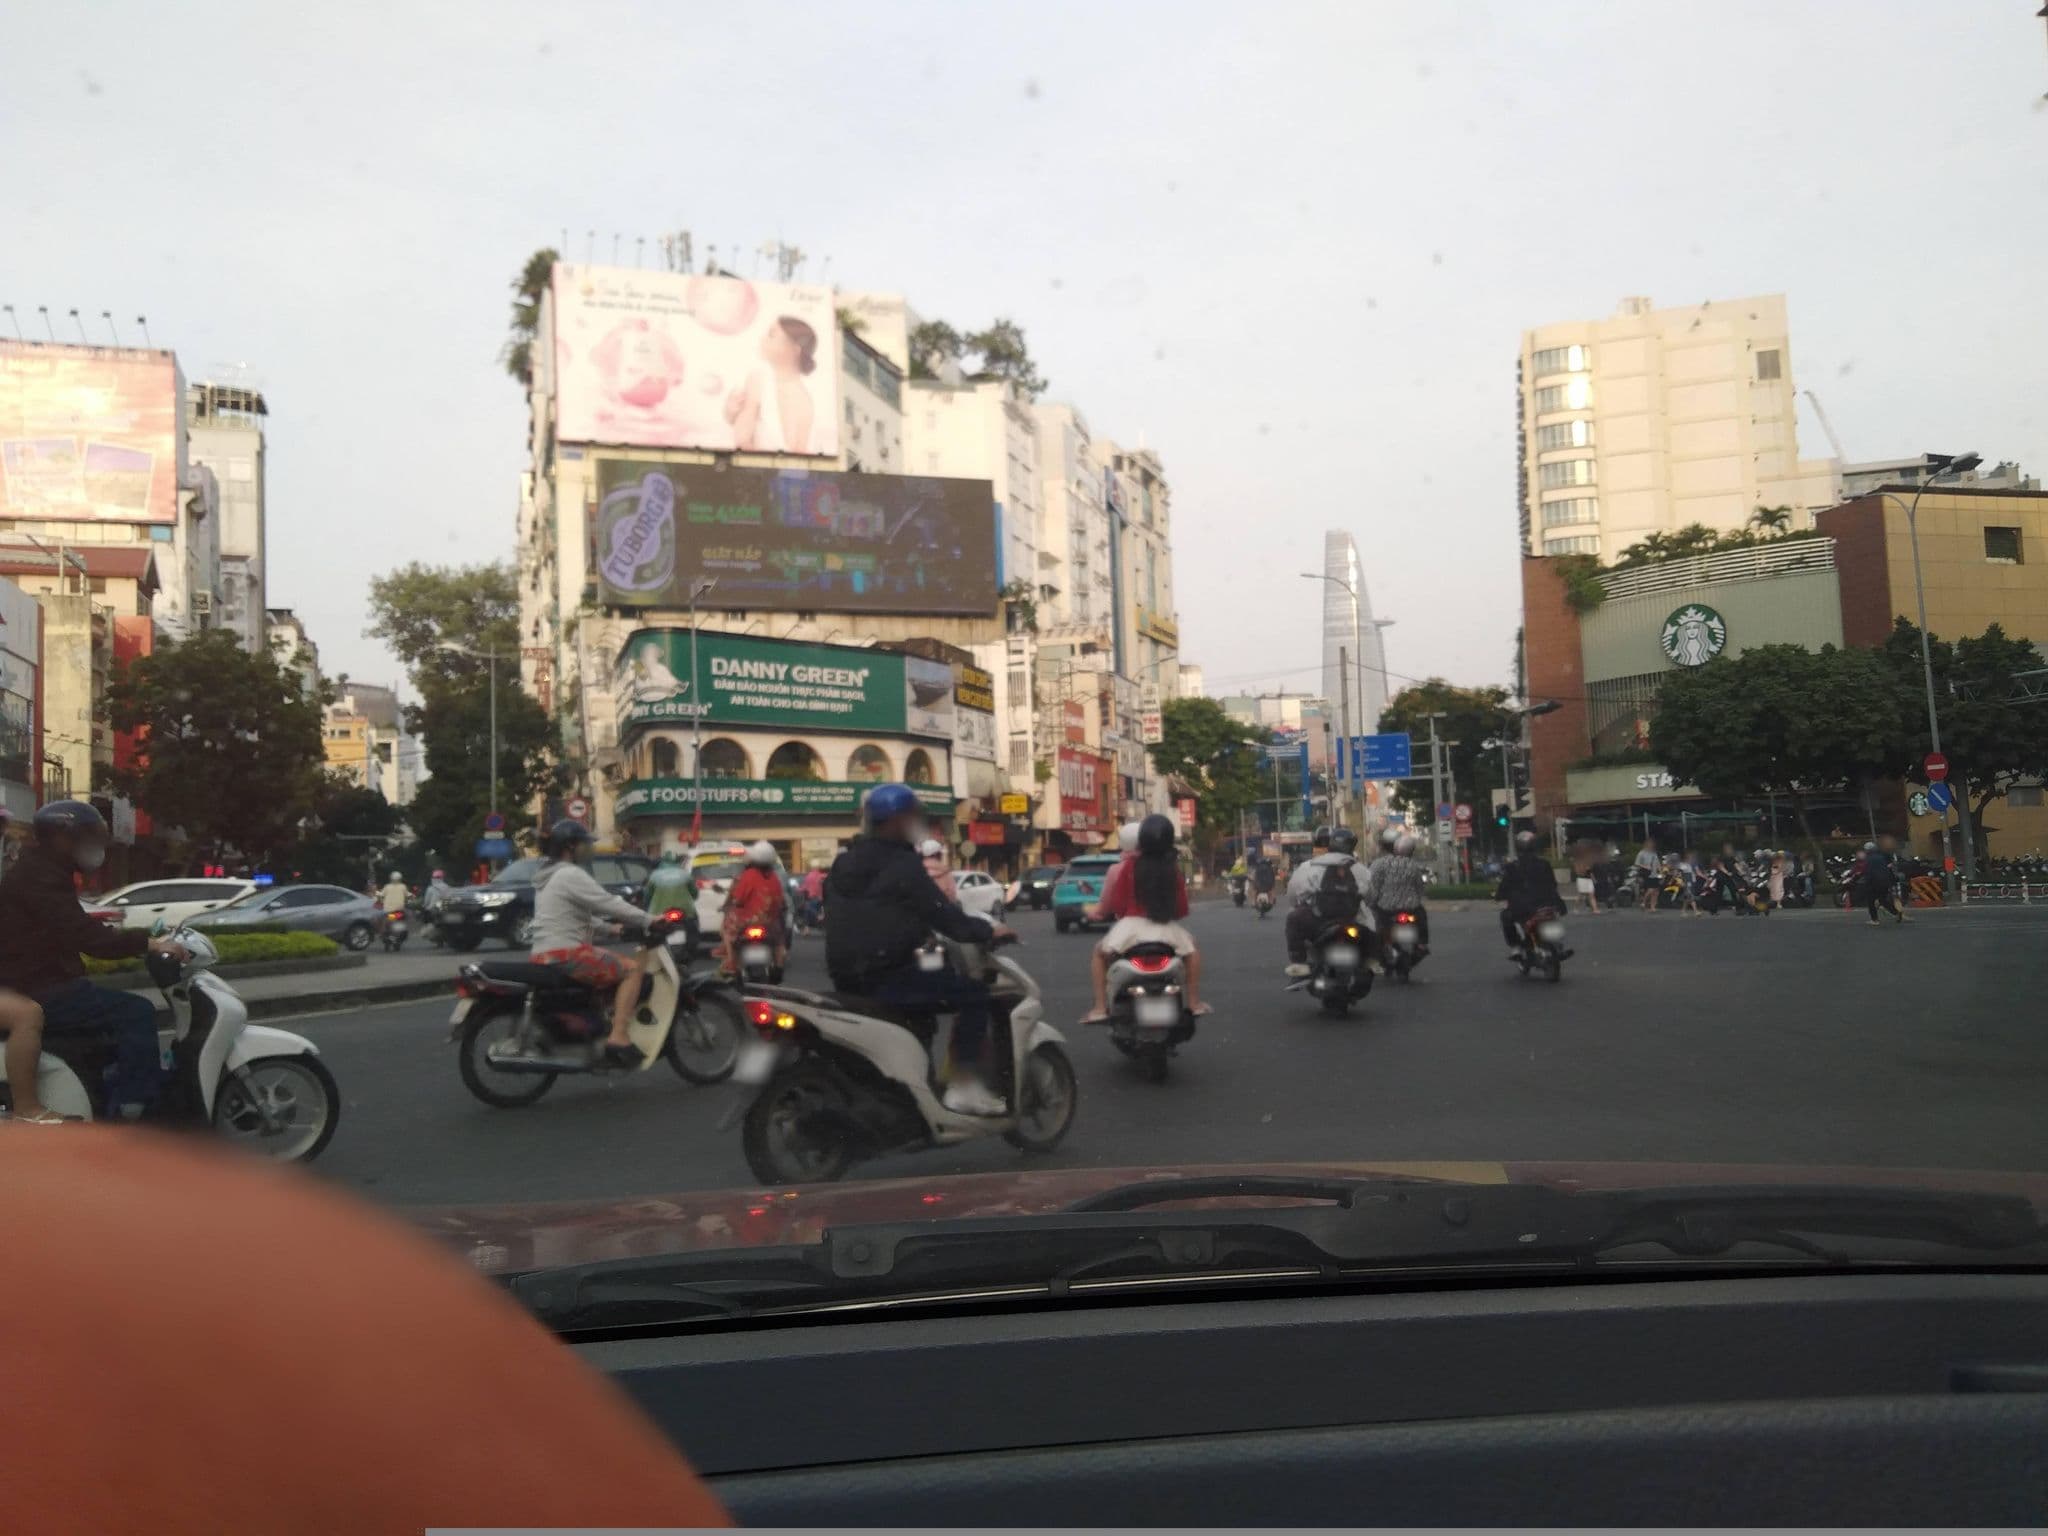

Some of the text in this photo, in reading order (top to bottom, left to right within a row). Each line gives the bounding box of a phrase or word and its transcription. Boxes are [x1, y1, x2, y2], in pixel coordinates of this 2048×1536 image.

[607, 498, 664, 580] TUBORG
[711, 657, 789, 681] DANNY
[652, 702, 709, 716] GREEN
[1060, 760, 1095, 800] OUTLET
[1636, 772, 1673, 789] STA
[652, 787, 747, 803] FOODSTUFFS
